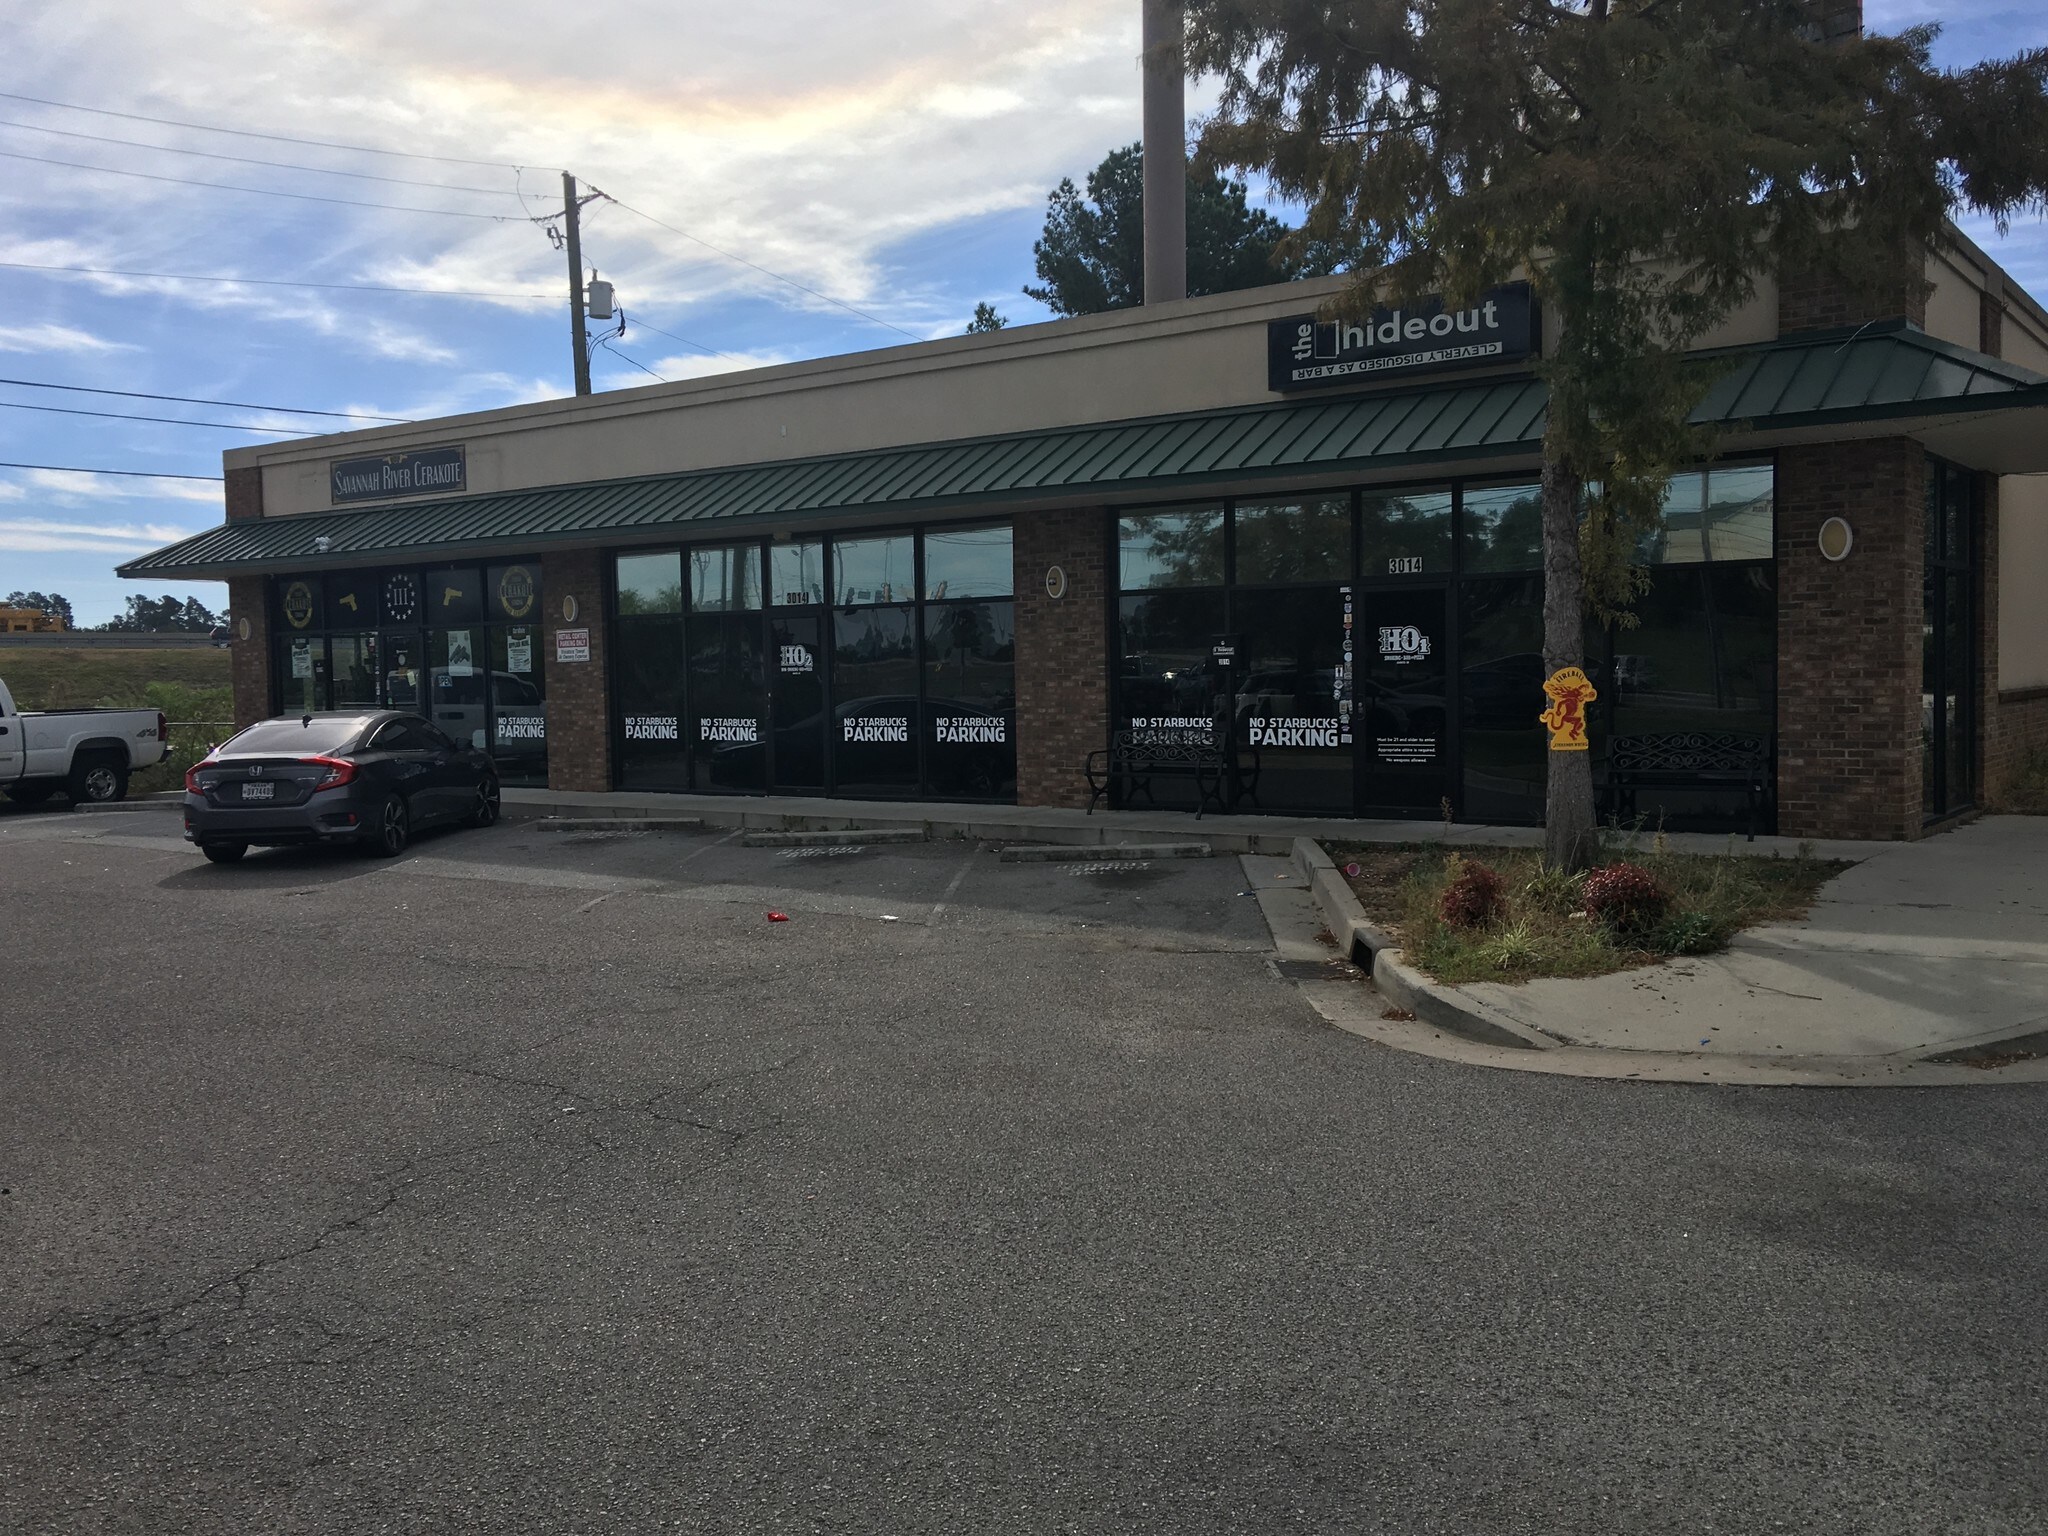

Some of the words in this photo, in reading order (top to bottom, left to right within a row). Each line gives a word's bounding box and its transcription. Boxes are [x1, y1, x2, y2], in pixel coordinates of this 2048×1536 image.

[1292, 324, 1312, 360] the
[1428, 343, 1497, 361] CLEVERLY
[1339, 362, 1354, 373] AS
[1359, 353, 1423, 370] DISGUISED
[1298, 368, 1322, 378] BAR
[1326, 366, 1335, 375] A
[335, 471, 379, 495] SAVANNAH
[383, 465, 410, 489] RIVER
[414, 461, 460, 486] CERAKOTE
[1390, 558, 1421, 573] 3014
[1554, 671, 1584, 683] FIREBALL
[508, 717, 544, 725] STARBUCKS
[637, 717, 677, 725] STARBUCKS
[701, 718, 711, 726] NO
[713, 718, 757, 727] STARBUCKS
[843, 718, 856, 727] NO
[858, 718, 907, 726] STARBUCKS
[936, 717, 949, 726] NO
[951, 717, 1005, 726] STARBUCKS
[1132, 717, 1147, 728] NO
[1150, 717, 1213, 728] STARBUCKS
[1249, 718, 1265, 728] NO
[1269, 718, 1338, 728] STARBUCKS
[498, 725, 544, 738] PARKING
[625, 726, 677, 739] PARKING
[701, 727, 757, 741] PARKING
[844, 727, 908, 742] PARKING
[936, 727, 1005, 743] PARKING
[1250, 728, 1338, 746] PARKING
